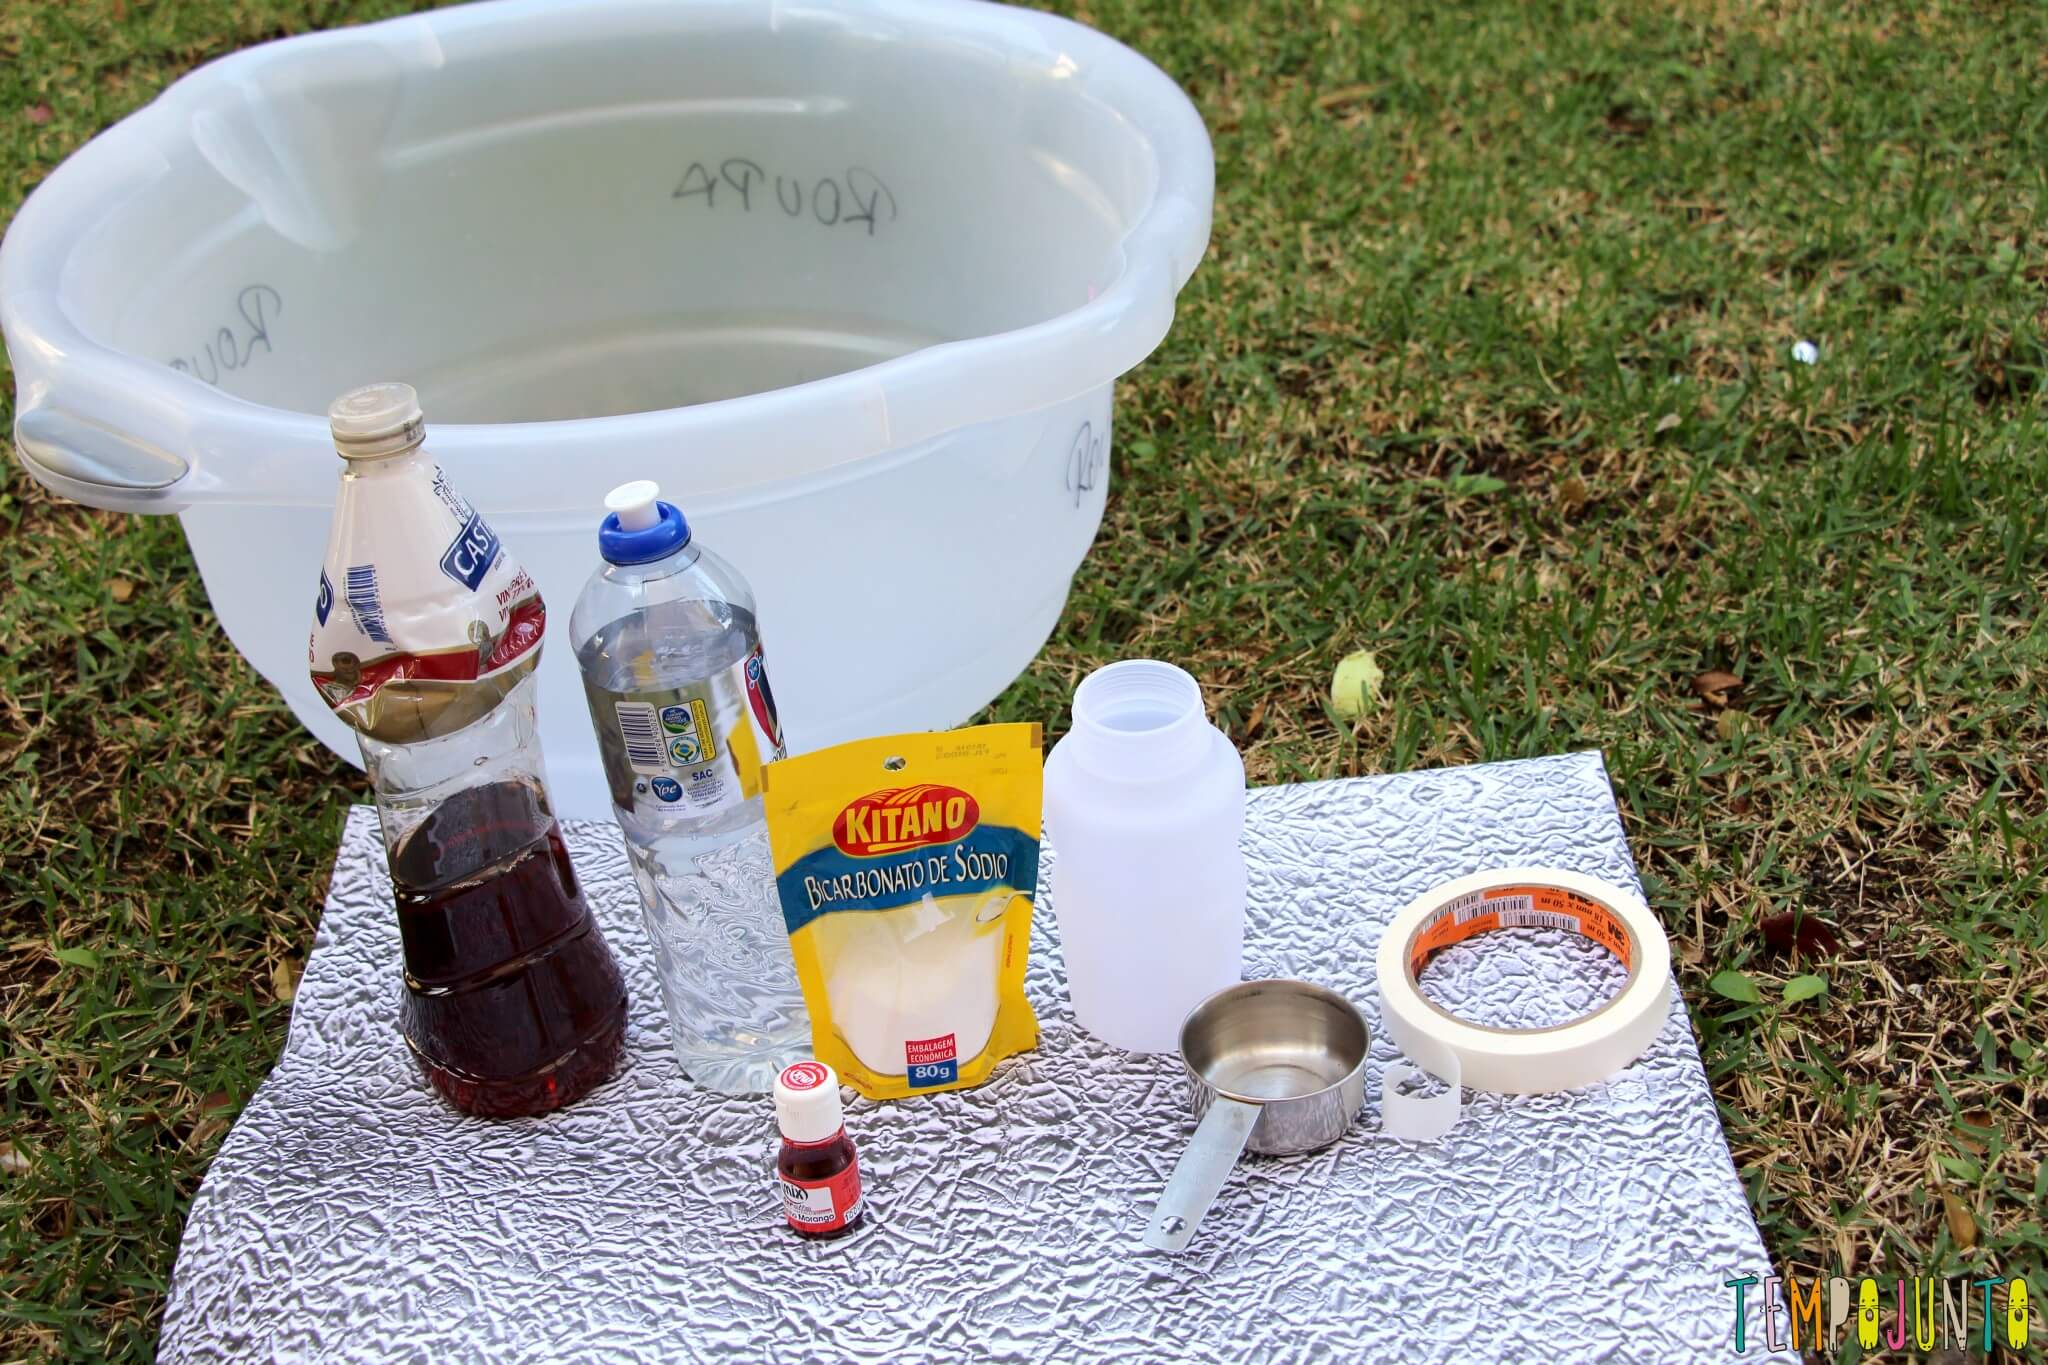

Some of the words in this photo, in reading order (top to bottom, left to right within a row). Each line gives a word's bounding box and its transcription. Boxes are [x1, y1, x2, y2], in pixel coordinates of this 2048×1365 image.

[692, 769, 713, 781] SAC
[846, 796, 967, 845] KITANO
[804, 861, 924, 911] BICARBONATO
[928, 856, 951, 885] DE
[954, 844, 1008, 882] SÓDIO
[907, 1038, 954, 1053] EMBALAGEM
[910, 1049, 954, 1063] ECONÔMICA
[915, 1065, 950, 1079] 80g
[798, 1213, 835, 1223] Morango
